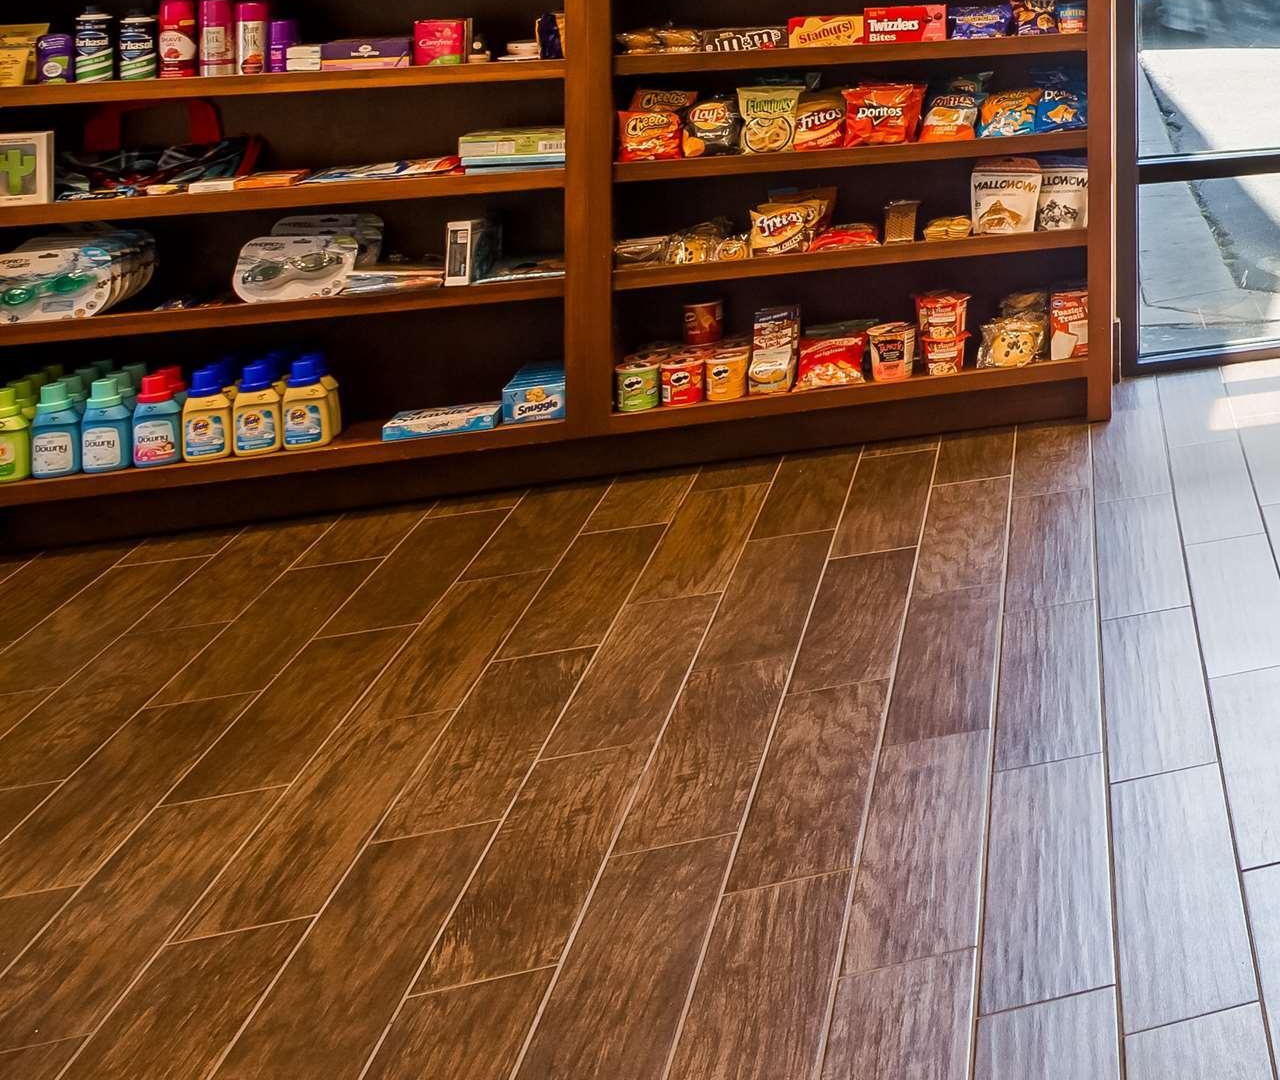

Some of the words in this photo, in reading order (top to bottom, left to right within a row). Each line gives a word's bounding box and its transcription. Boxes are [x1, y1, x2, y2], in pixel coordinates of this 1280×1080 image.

[799, 19, 854, 45] Starburst
[867, 18, 919, 32] Twizzlers
[869, 32, 897, 42] Bites
[121, 39, 153, 50] arbasol
[640, 91, 689, 108] Cheetos
[798, 108, 843, 134] Fritos
[856, 105, 904, 123] Doritos
[517, 400, 559, 416] Snuggle
[84, 439, 116, 449] Downy
[138, 434, 169, 444] Downy
[34, 443, 68, 454] Downy
